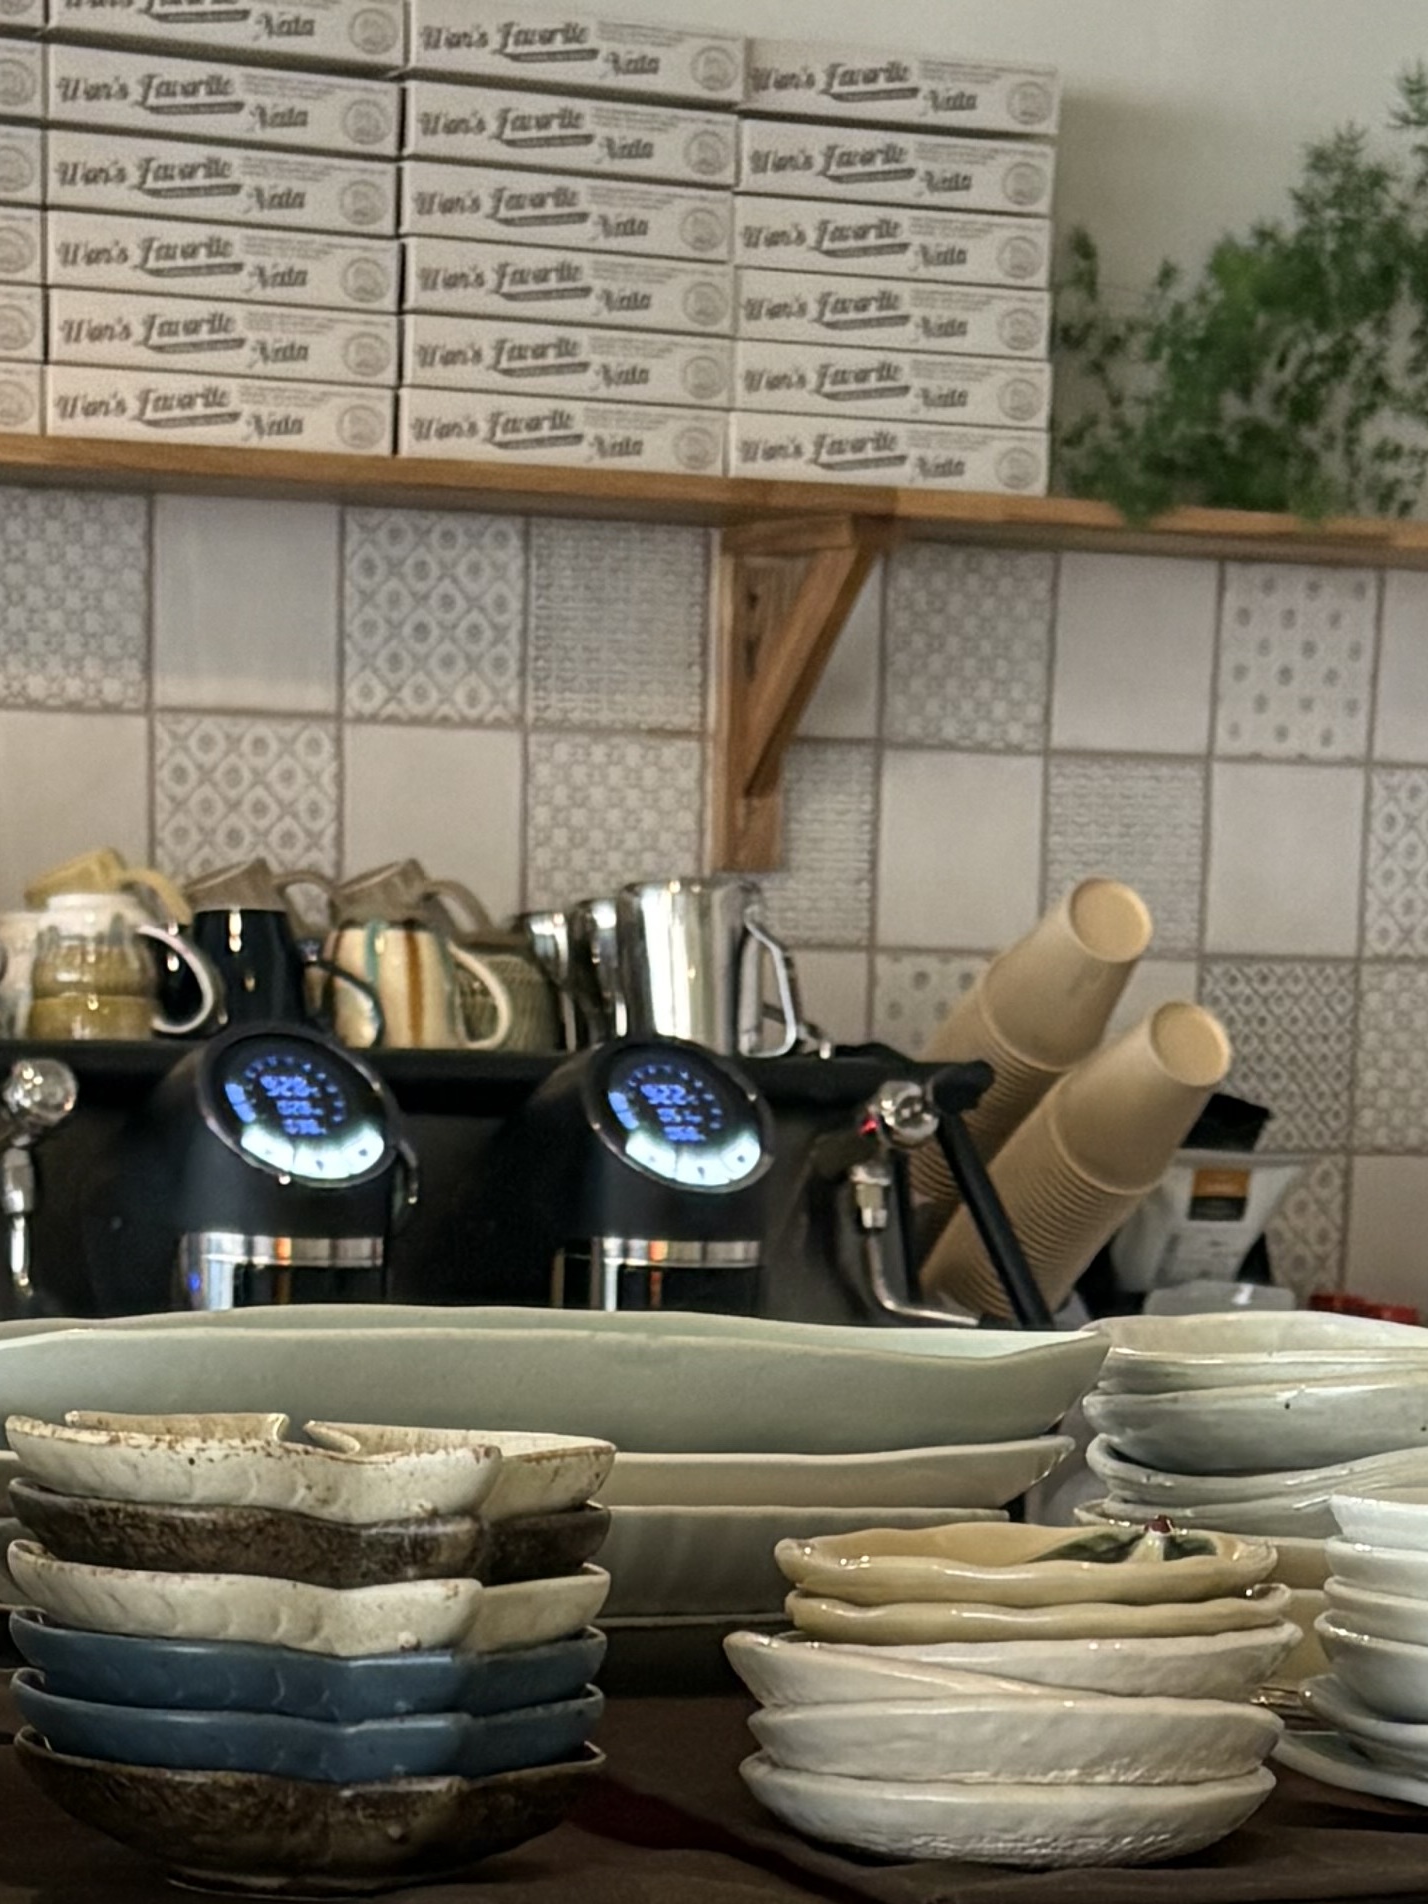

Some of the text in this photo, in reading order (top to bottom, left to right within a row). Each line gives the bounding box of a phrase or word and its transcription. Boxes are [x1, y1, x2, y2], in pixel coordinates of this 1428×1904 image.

[252, 11, 315, 41] Nata
[132, 73, 233, 107] Favorite
[246, 102, 309, 132] Nata
[130, 156, 231, 190] Favorite
[243, 184, 306, 214] Nata
[132, 235, 233, 269] Favorite
[245, 262, 308, 292] Nata
[134, 311, 235, 345] Favorite
[247, 337, 310, 367] Nata
[129, 386, 230, 420] Favorite
[242, 410, 305, 440] Nata
